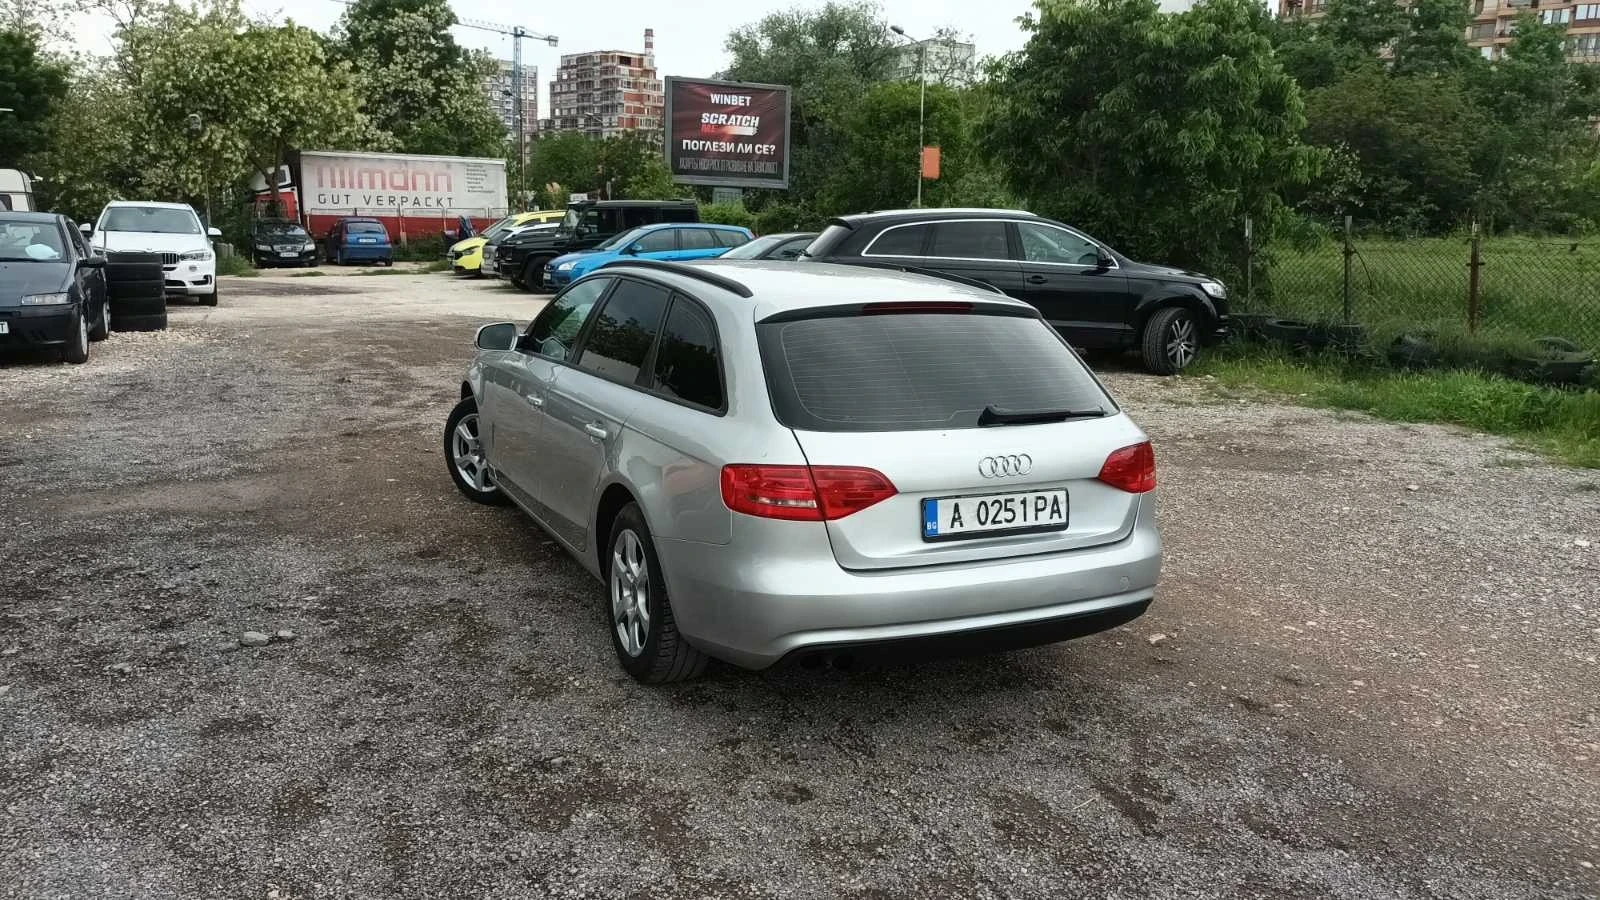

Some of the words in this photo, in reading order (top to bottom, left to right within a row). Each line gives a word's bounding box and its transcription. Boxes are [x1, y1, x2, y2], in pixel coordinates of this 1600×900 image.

[710, 93, 751, 106] WINBET
[701, 112, 760, 127] SCRATCH
[682, 139, 735, 153] ПОГЛЕЗИ
[737, 143, 753, 154] ЛИ
[755, 144, 776, 155] СЕ?
[318, 194, 352, 205] GUT
[363, 195, 455, 208] VERPACKT
[950, 503, 963, 528] A
